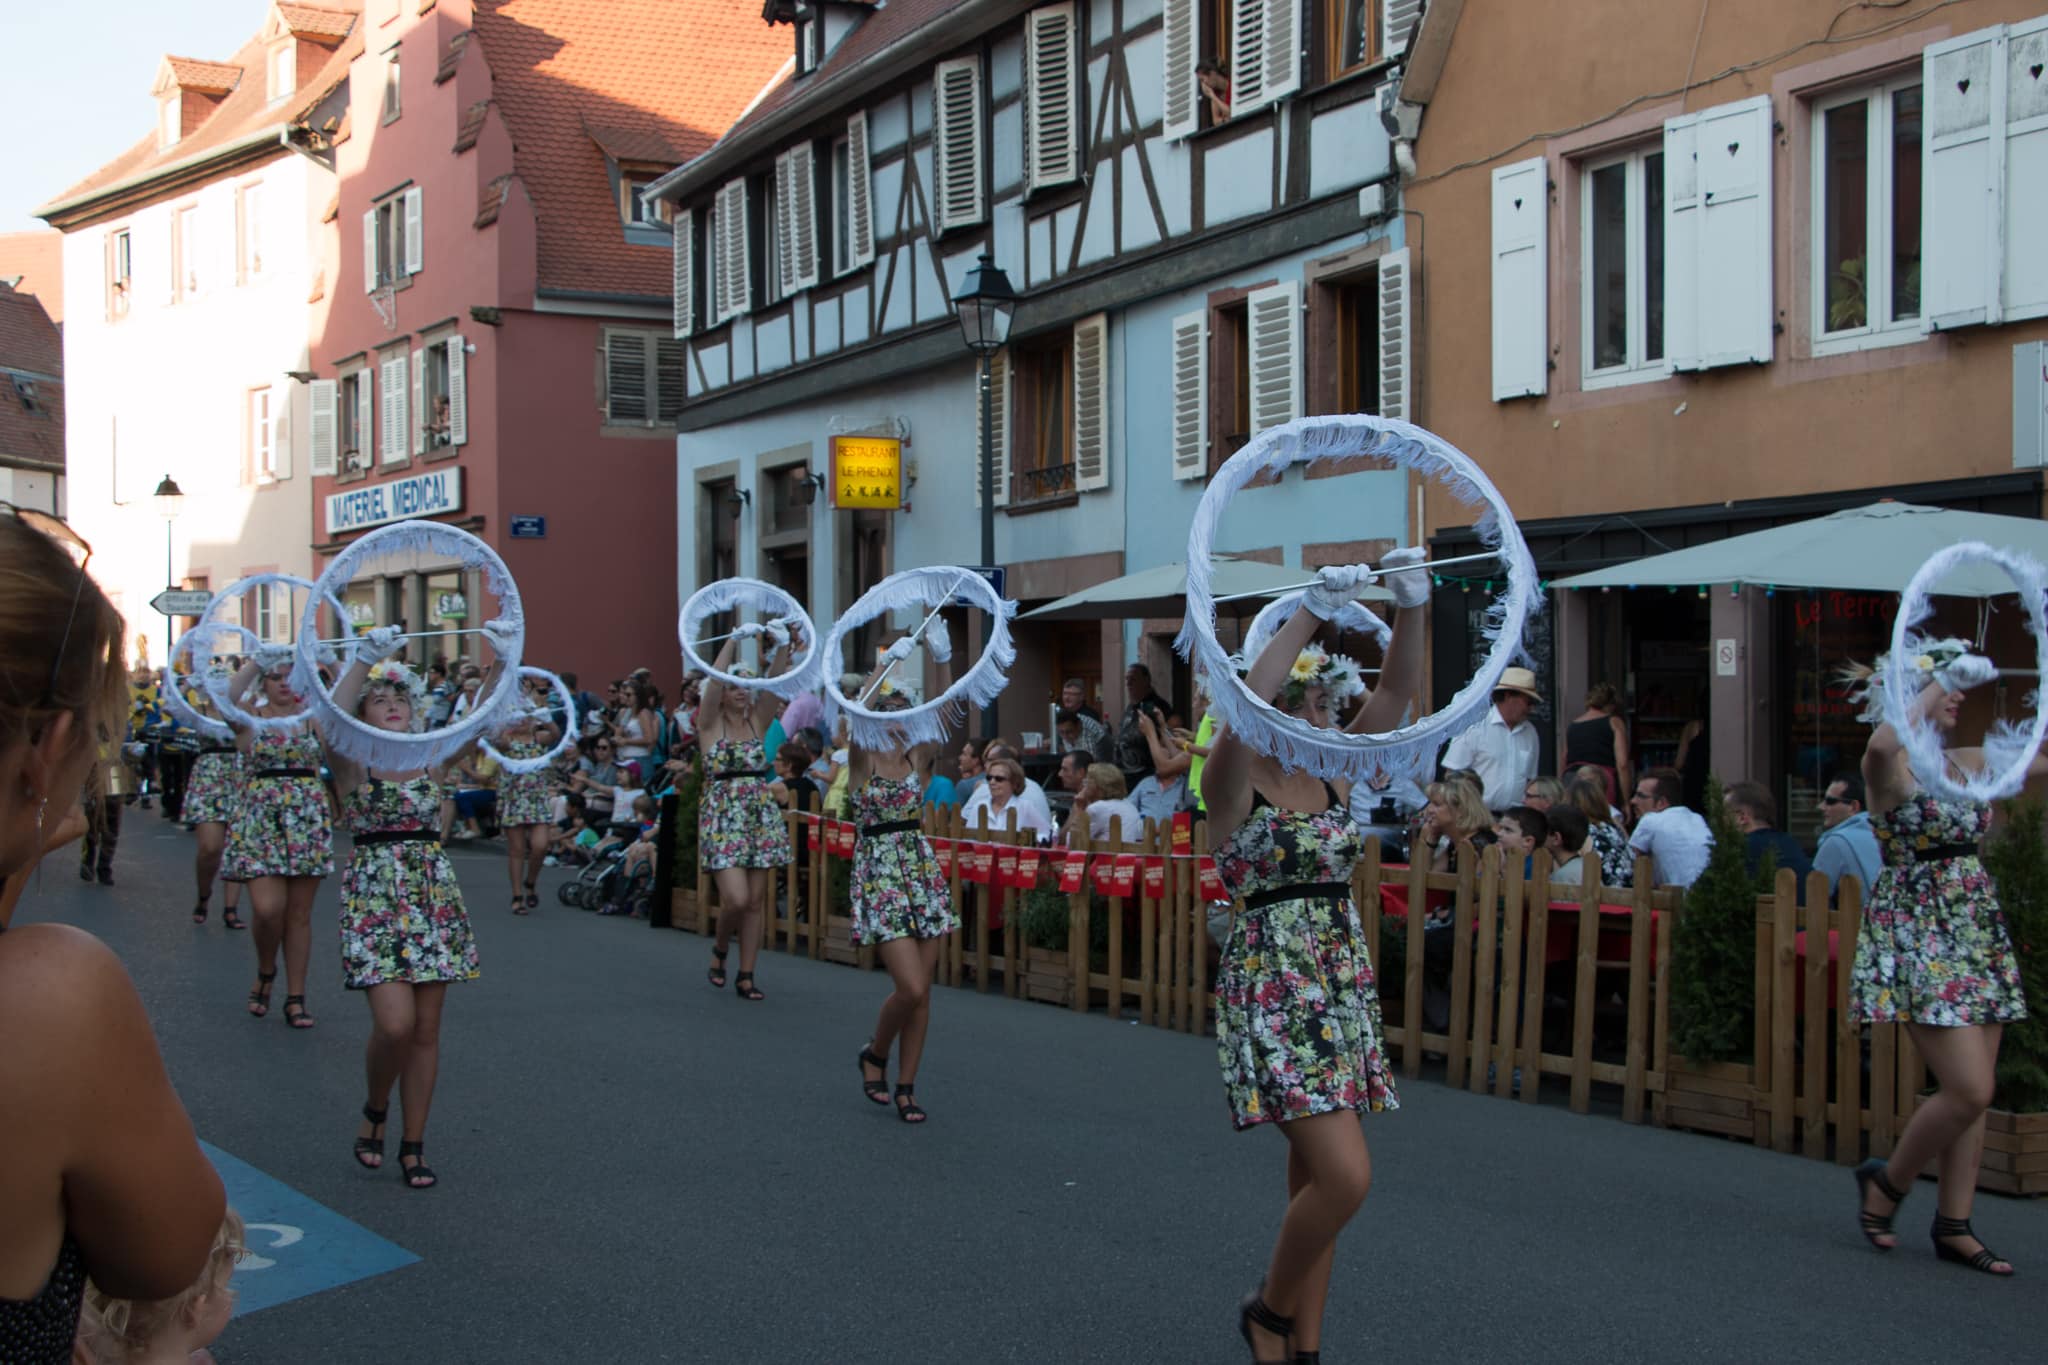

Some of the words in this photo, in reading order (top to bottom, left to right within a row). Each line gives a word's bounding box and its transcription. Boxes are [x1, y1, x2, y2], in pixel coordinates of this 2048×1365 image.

[837, 445, 897, 458] RESTAURANT
[841, 465, 855, 477] LE
[857, 466, 894, 478] PHENIX
[332, 487, 388, 529] MATERIEL
[391, 472, 450, 516] MEDICAL
[1794, 600, 1824, 627] Le
